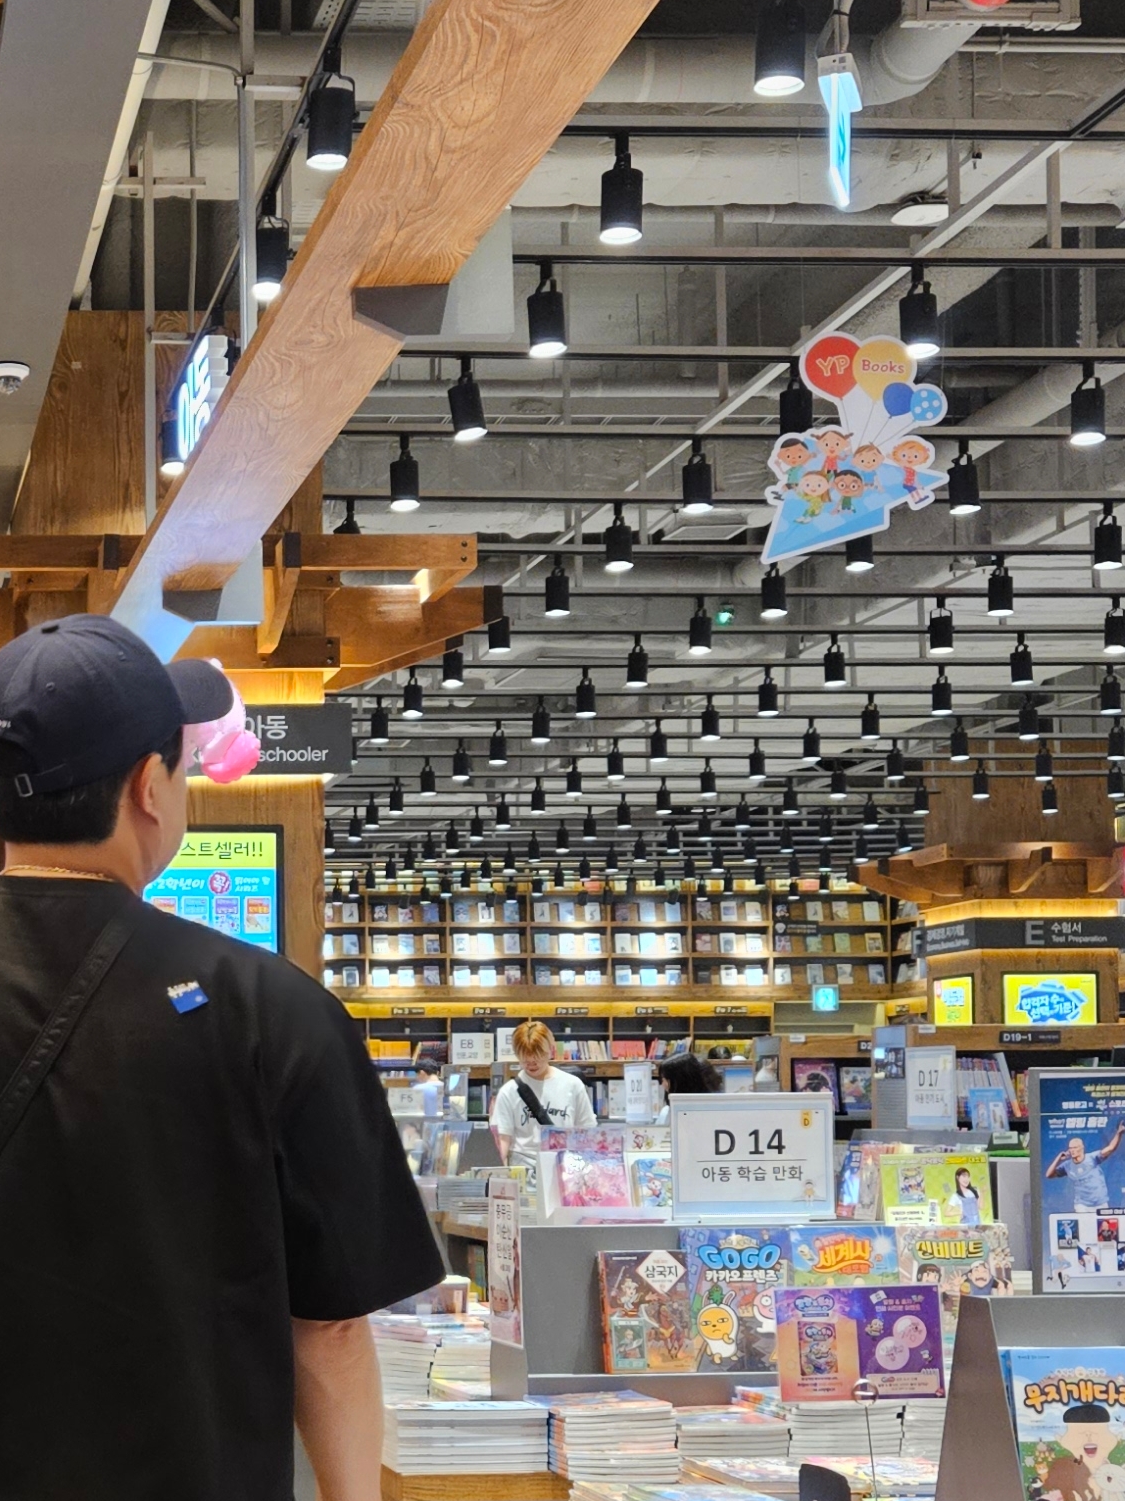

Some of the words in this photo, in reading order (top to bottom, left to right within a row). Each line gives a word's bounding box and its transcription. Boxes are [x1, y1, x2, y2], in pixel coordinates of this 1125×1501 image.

[815, 355, 851, 376] YP
[861, 359, 905, 374] Books
[1026, 920, 1045, 944] E
[1051, 922, 1082, 934] 수험서
[1052, 935, 1066, 943] Test
[1068, 935, 1107, 944] Preparation
[631, 1079, 636, 1092] D
[919, 1070, 926, 1087] D
[928, 1069, 940, 1087] 17
[714, 1129, 736, 1156] D
[748, 1128, 786, 1155] 14
[701, 1166, 732, 1182] 아동
[737, 1165, 767, 1182] 학습
[772, 1165, 803, 1181] 만화
[819, 1241, 872, 1266] 세계사
[644, 1265, 678, 1278] 삼국지
